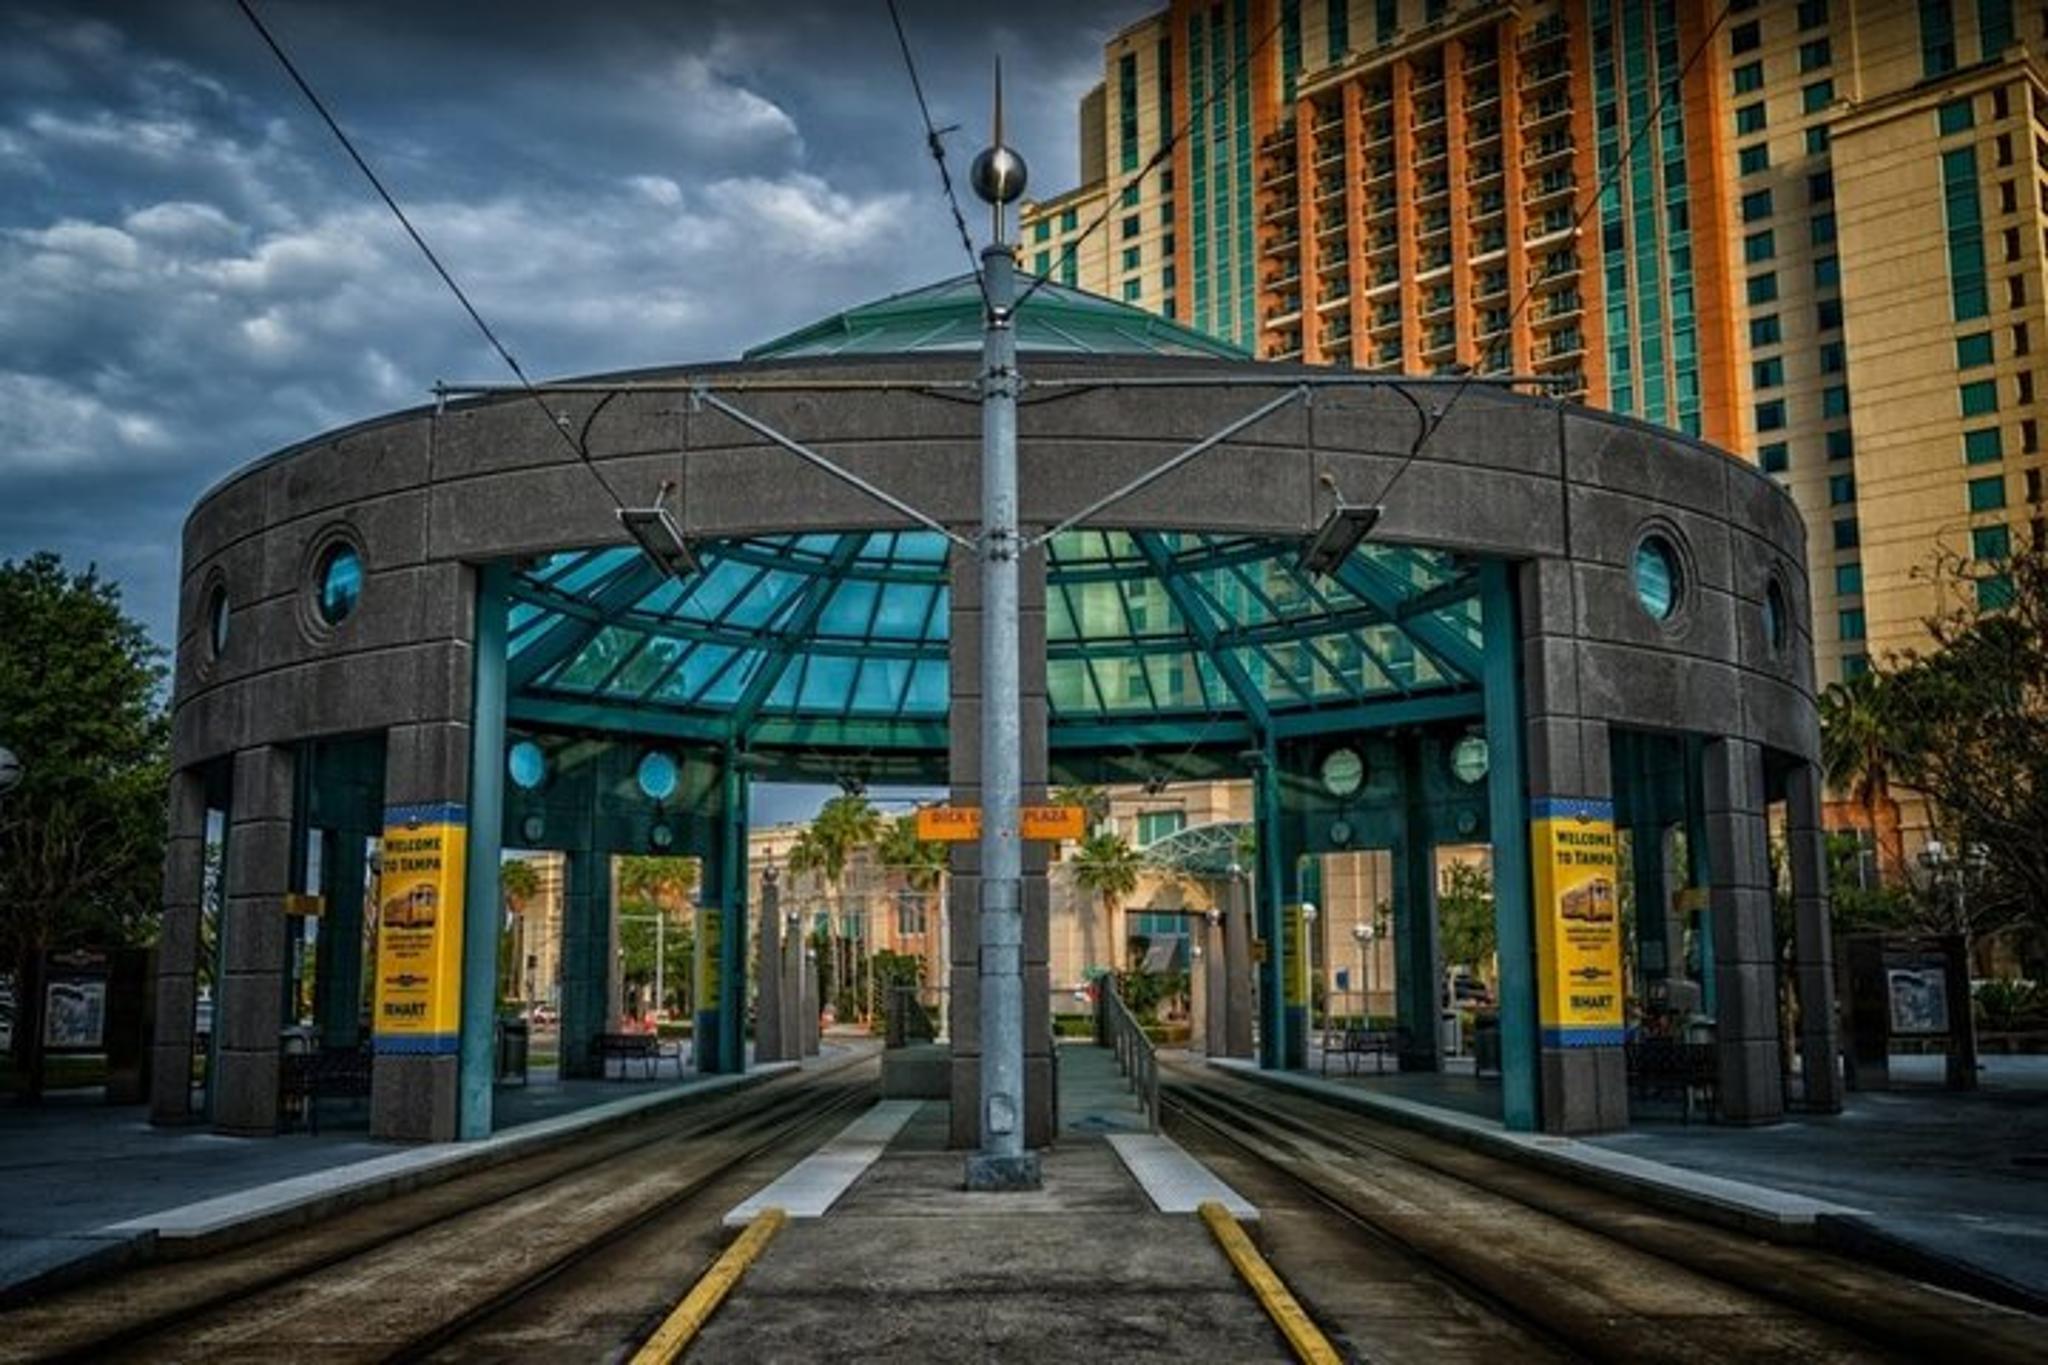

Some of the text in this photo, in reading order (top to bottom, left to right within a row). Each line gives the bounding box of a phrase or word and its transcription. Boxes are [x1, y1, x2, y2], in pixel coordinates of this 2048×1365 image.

[1023, 809, 1068, 823] PLAZA
[386, 838, 441, 852] WELCOME
[383, 858, 441, 873] TO TAMPA
[1557, 851, 1614, 866] TO TAMPA
